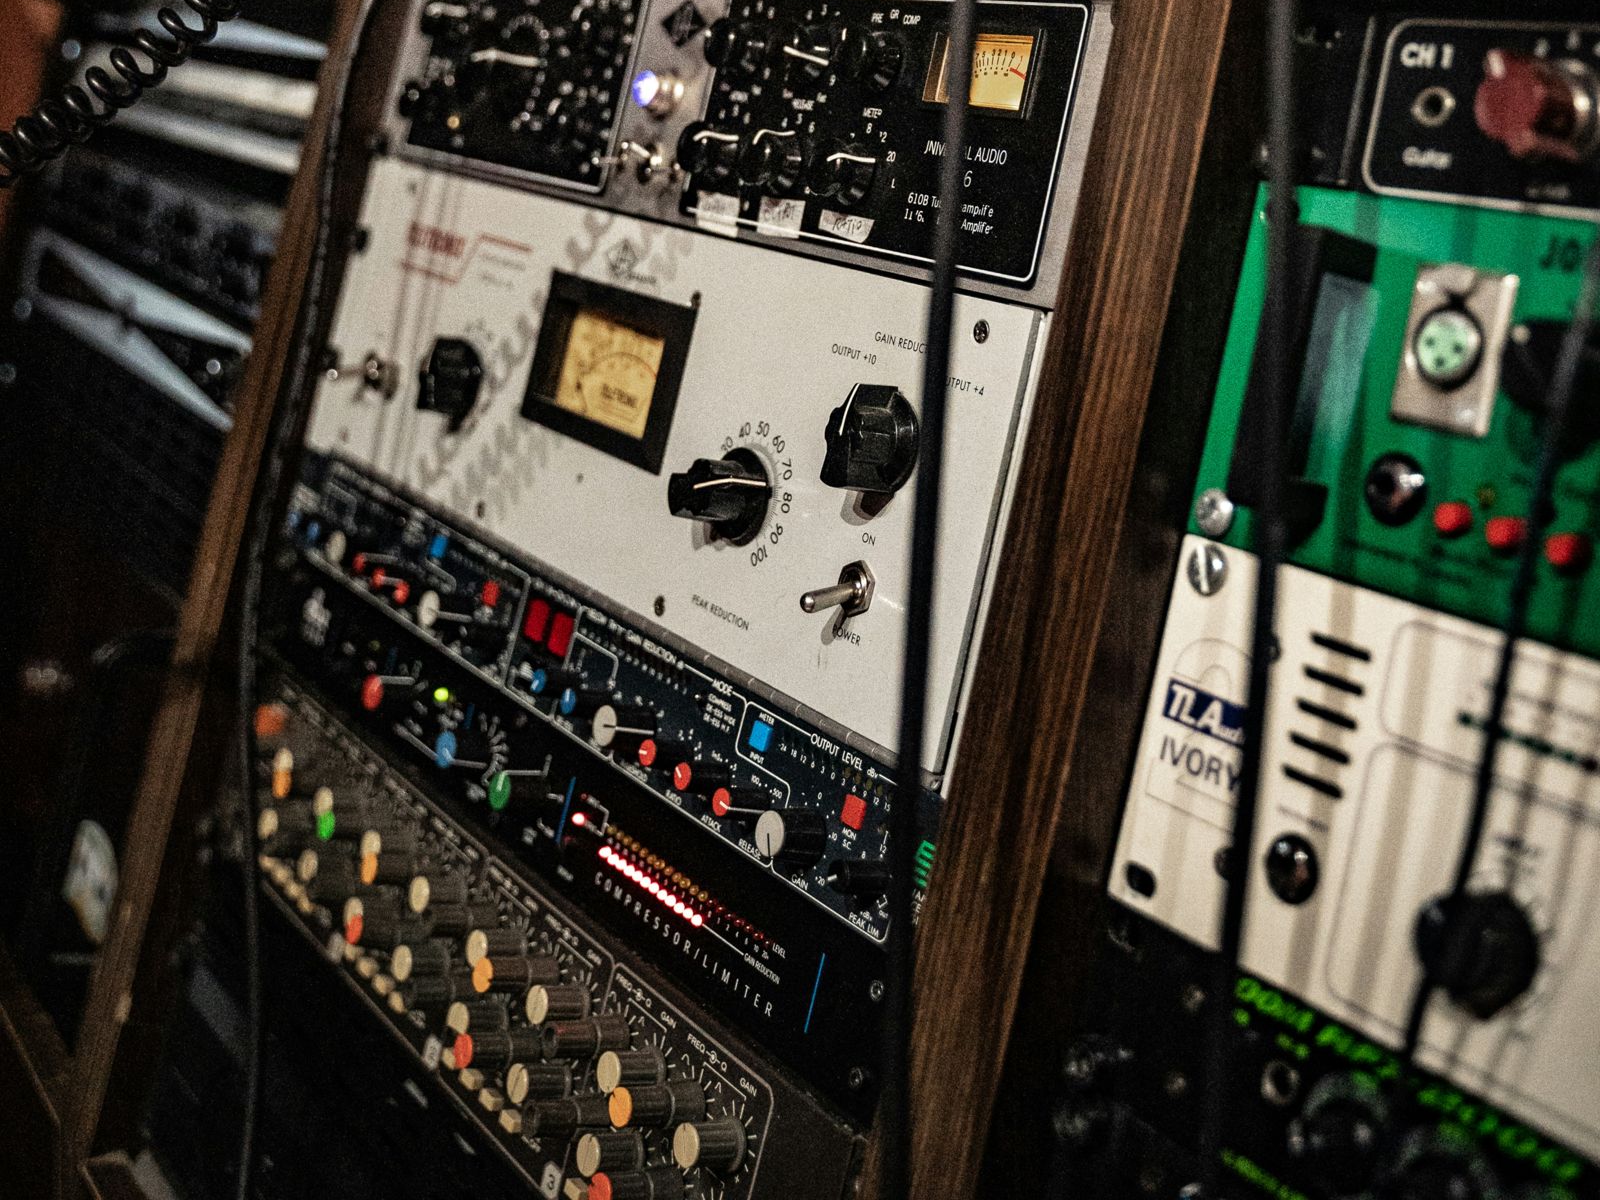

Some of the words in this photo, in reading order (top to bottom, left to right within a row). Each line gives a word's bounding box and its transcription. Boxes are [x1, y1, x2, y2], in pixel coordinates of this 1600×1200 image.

[871, 12, 884, 24] PRE
[890, 9, 899, 19] GR
[903, 14, 920, 25] COMP
[886, 150, 896, 162] 20
[974, 147, 1008, 165] AUDIO
[908, 192, 929, 207] 610B
[874, 331, 896, 346] GAIN
[898, 337, 927, 354] REDUC
[831, 343, 861, 360] OUTPUT
[863, 353, 877, 365] +10
[945, 377, 971, 392] UTPUT
[973, 385, 985, 396] +4
[738, 422, 751, 438] 40
[755, 420, 770, 438] 50
[772, 435, 785, 453] 60
[782, 458, 793, 481] 70
[781, 492, 793, 513] 80
[770, 523, 784, 544] 90
[862, 533, 876, 546] ON
[750, 545, 768, 567] 100
[692, 594, 708, 610] PEAK
[710, 601, 749, 631] REDUCTION
[832, 624, 861, 646] POWER
[712, 679, 733, 697] MODE
[1168, 683, 1224, 735] TLA
[759, 712, 775, 726] METER
[810, 733, 840, 756] OUTPUT
[842, 750, 863, 771] LEVEL
[1159, 735, 1240, 793] IVORY
[817, 792, 822, 800] 0
[701, 814, 722, 833] ATTACK
[841, 827, 857, 841] MON
[738, 838, 761, 860] RELEASE
[880, 844, 887, 854] 12
[791, 874, 808, 891] GAIN
[848, 912, 866, 929] PEAK
[867, 924, 880, 938] LIM
[595, 871, 773, 1017] COMPRESSOR/LIMITER
[772, 943, 786, 959] LEVEL
[744, 953, 756, 967] GAIN
[755, 961, 780, 985] REDUCTION
[660, 1011, 677, 1029] GAIN
[687, 1033, 706, 1054] FREQ
[720, 1062, 728, 1073] Q
[739, 1077, 757, 1097] GAIN
